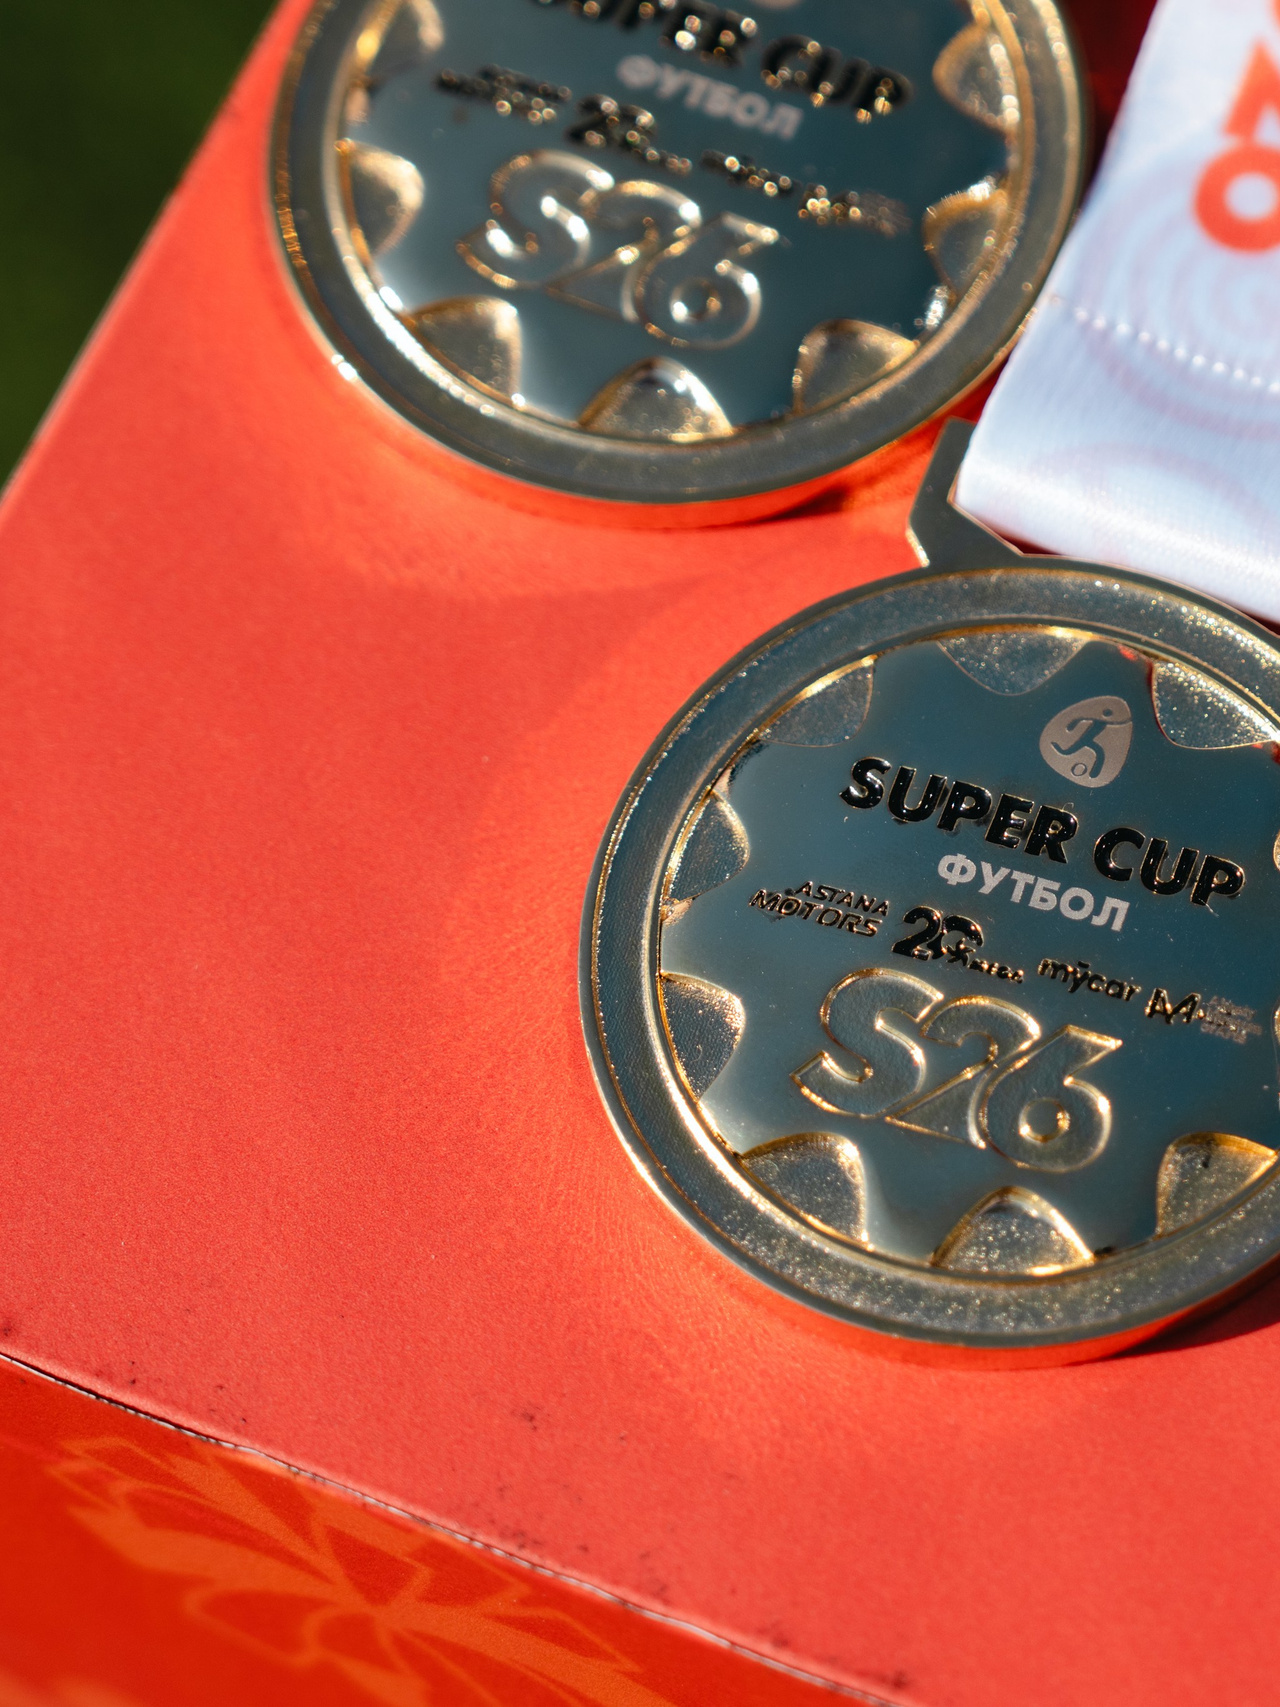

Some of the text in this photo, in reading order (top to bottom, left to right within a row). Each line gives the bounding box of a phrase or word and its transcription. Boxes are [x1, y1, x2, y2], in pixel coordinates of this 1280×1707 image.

[616, 53, 803, 141] ФУТБОЛ
[761, 34, 914, 122] CUP
[457, 149, 781, 349] S26
[839, 756, 1246, 906] SUPER CUP
[749, 888, 883, 938] MOTORS
[795, 880, 889, 917] ASTANA
[937, 854, 1130, 932] ФУТБОЛ
[790, 967, 1122, 1173] S26
